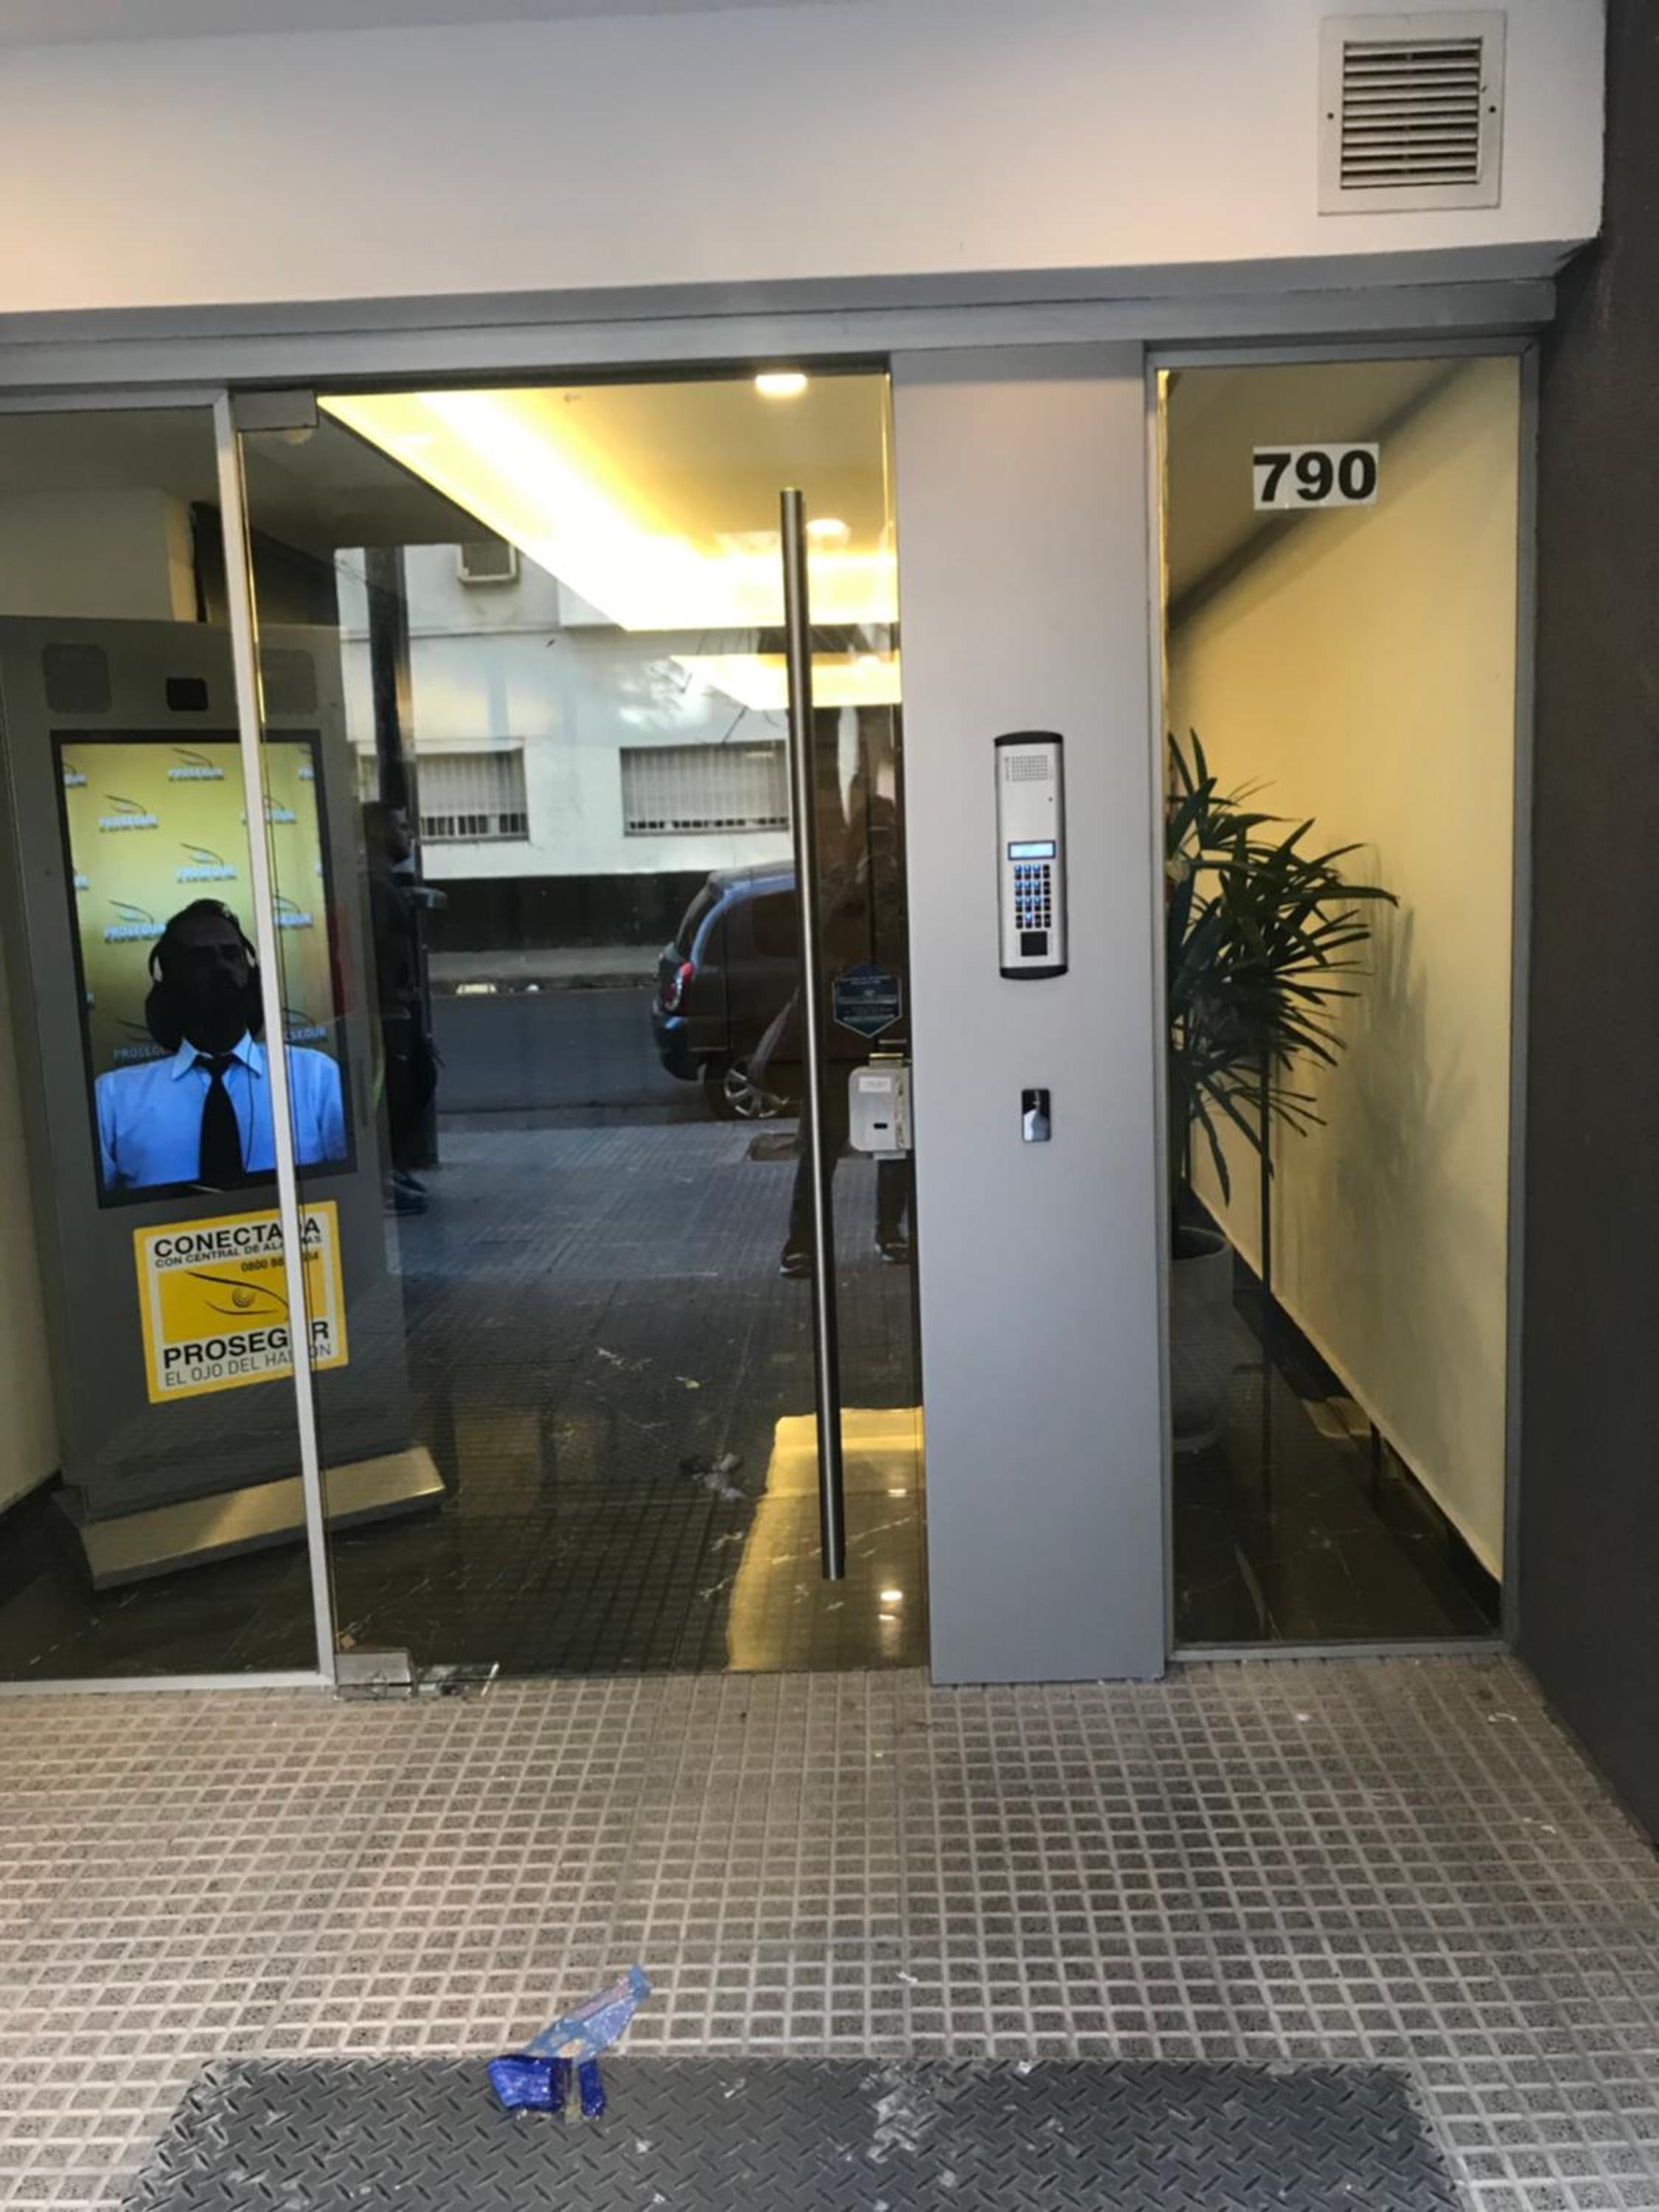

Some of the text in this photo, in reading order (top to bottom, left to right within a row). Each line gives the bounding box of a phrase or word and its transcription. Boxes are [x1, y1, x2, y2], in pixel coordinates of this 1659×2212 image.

[1253, 450, 1376, 501] 790
[154, 1217, 320, 1258] CONECTAA
[155, 1257, 182, 1267] CON
[186, 1249, 238, 1263] CENTRAL
[244, 1245, 260, 1254] DE
[164, 1321, 329, 1368] PROSEGR
[165, 1343, 331, 1386] EL OJO DEL HAON
